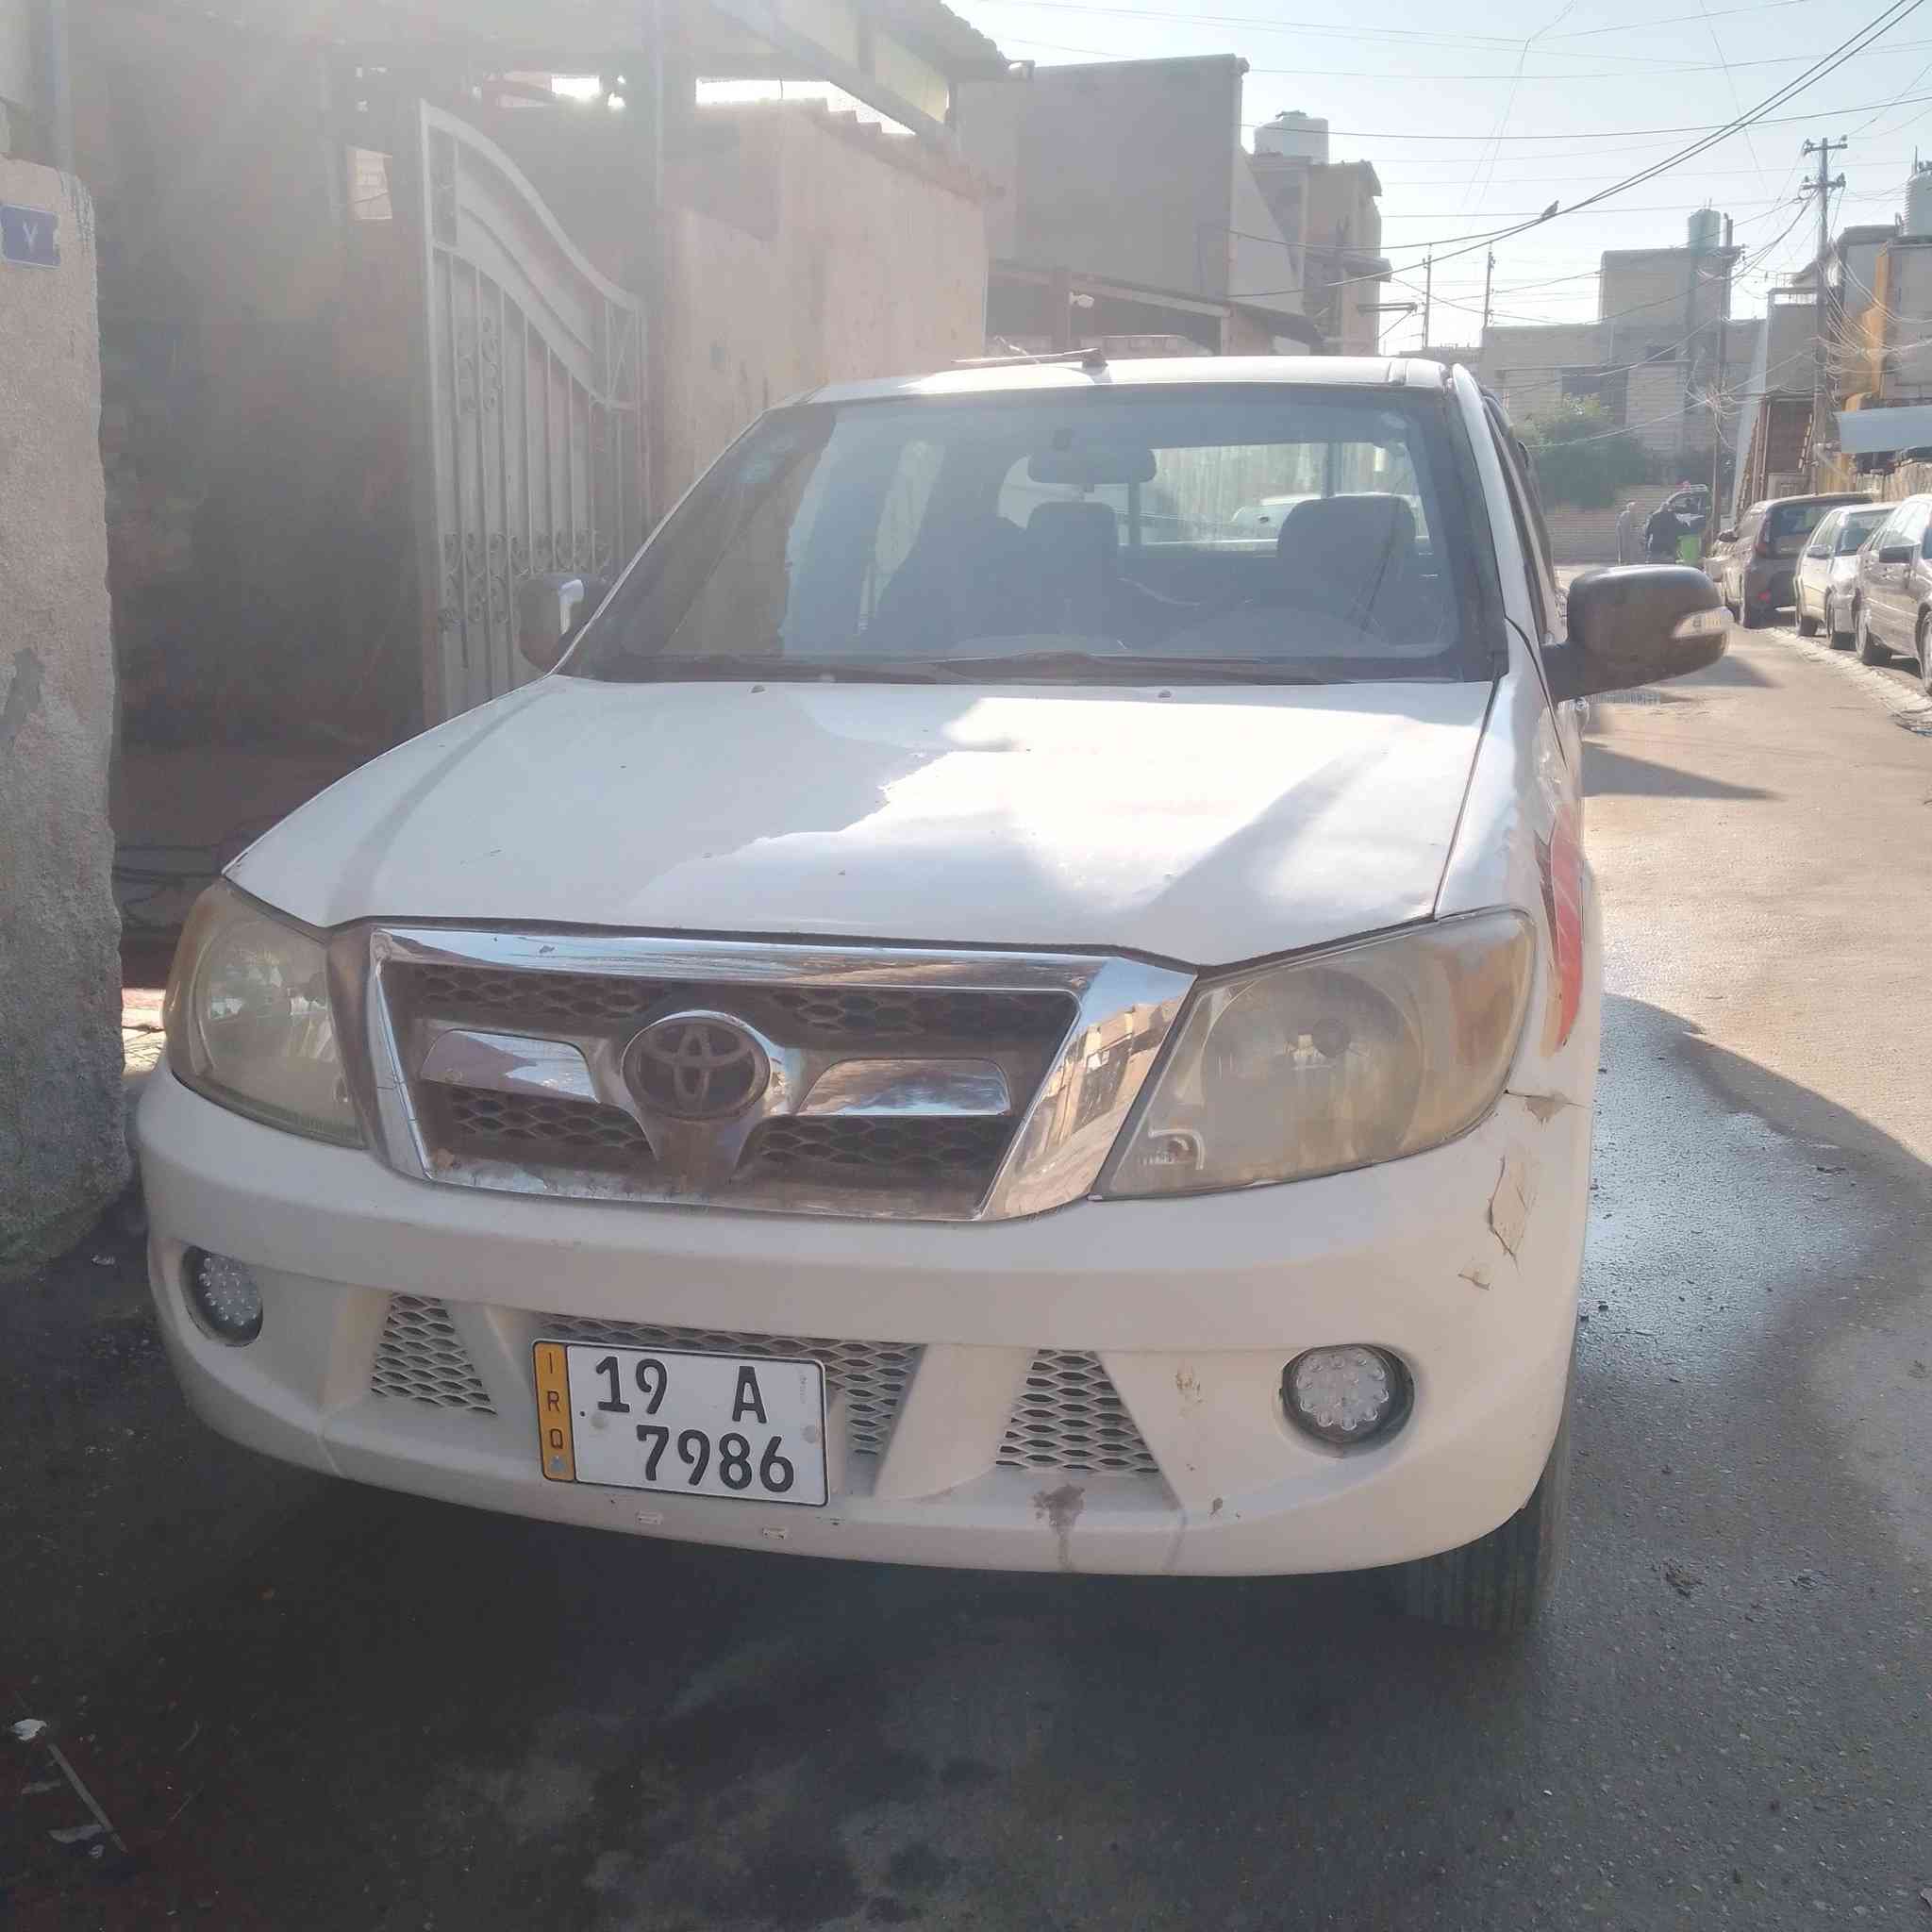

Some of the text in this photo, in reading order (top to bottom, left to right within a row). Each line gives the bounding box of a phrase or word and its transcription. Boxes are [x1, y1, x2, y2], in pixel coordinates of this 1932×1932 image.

[546, 1353, 564, 1449] IRQ
[595, 1356, 668, 1415] 19
[731, 1365, 768, 1424] A
[636, 1424, 794, 1493] 7986
